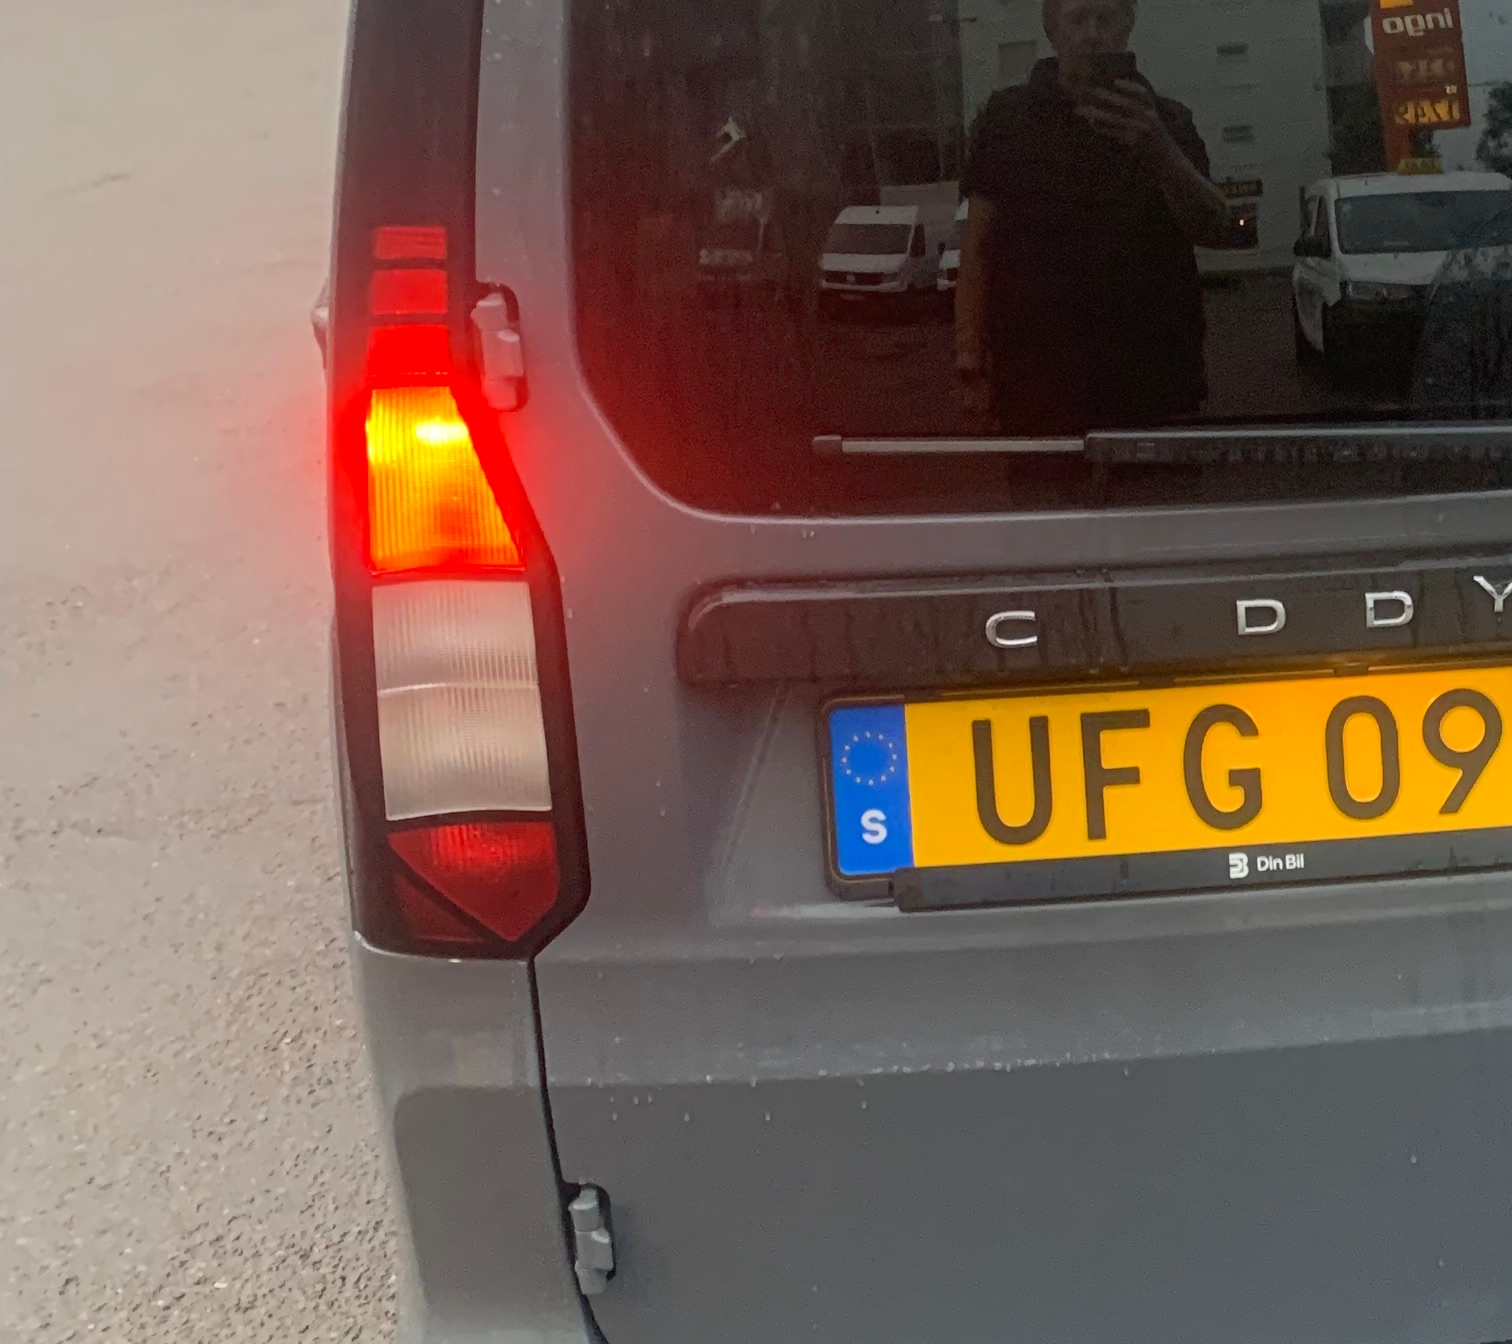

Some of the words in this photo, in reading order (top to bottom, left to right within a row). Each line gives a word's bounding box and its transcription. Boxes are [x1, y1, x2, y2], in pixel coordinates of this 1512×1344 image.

[971, 703, 1264, 845] UFG
[860, 809, 887, 845] S
[1256, 855, 1283, 872] Din
[1285, 853, 1305, 870] Bil
